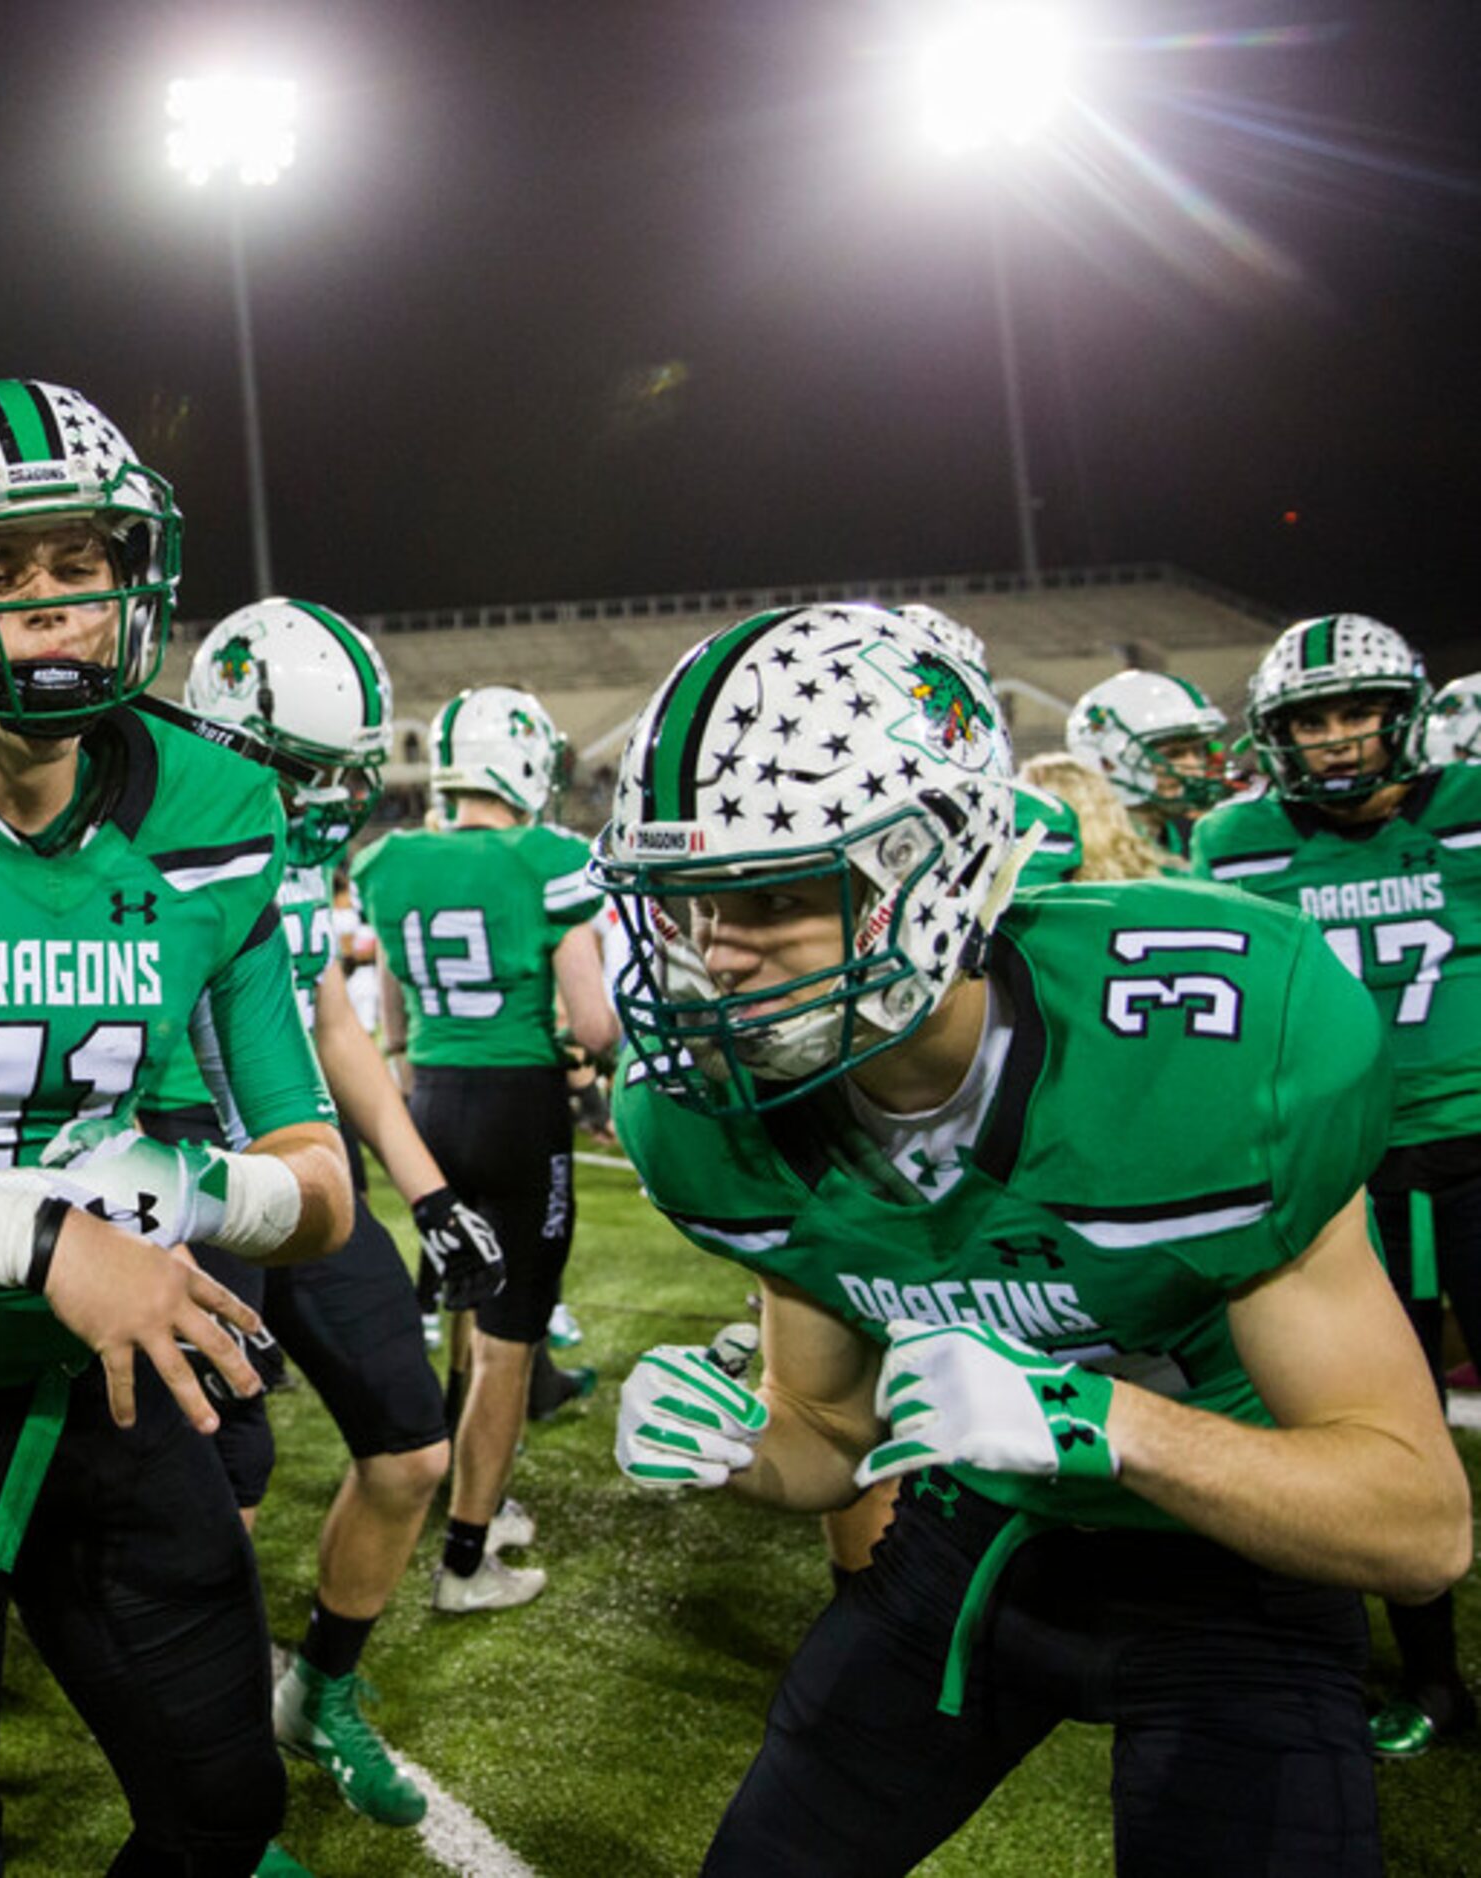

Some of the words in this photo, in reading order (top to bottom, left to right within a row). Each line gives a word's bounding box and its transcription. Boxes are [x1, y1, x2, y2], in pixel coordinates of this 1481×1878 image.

[637, 830, 686, 851] DRAGONS
[1298, 872, 1445, 921] DRAGONS
[402, 906, 505, 1019] 12
[1100, 928, 1250, 1042] 31
[837, 1273, 1102, 1340] DRAGONS
